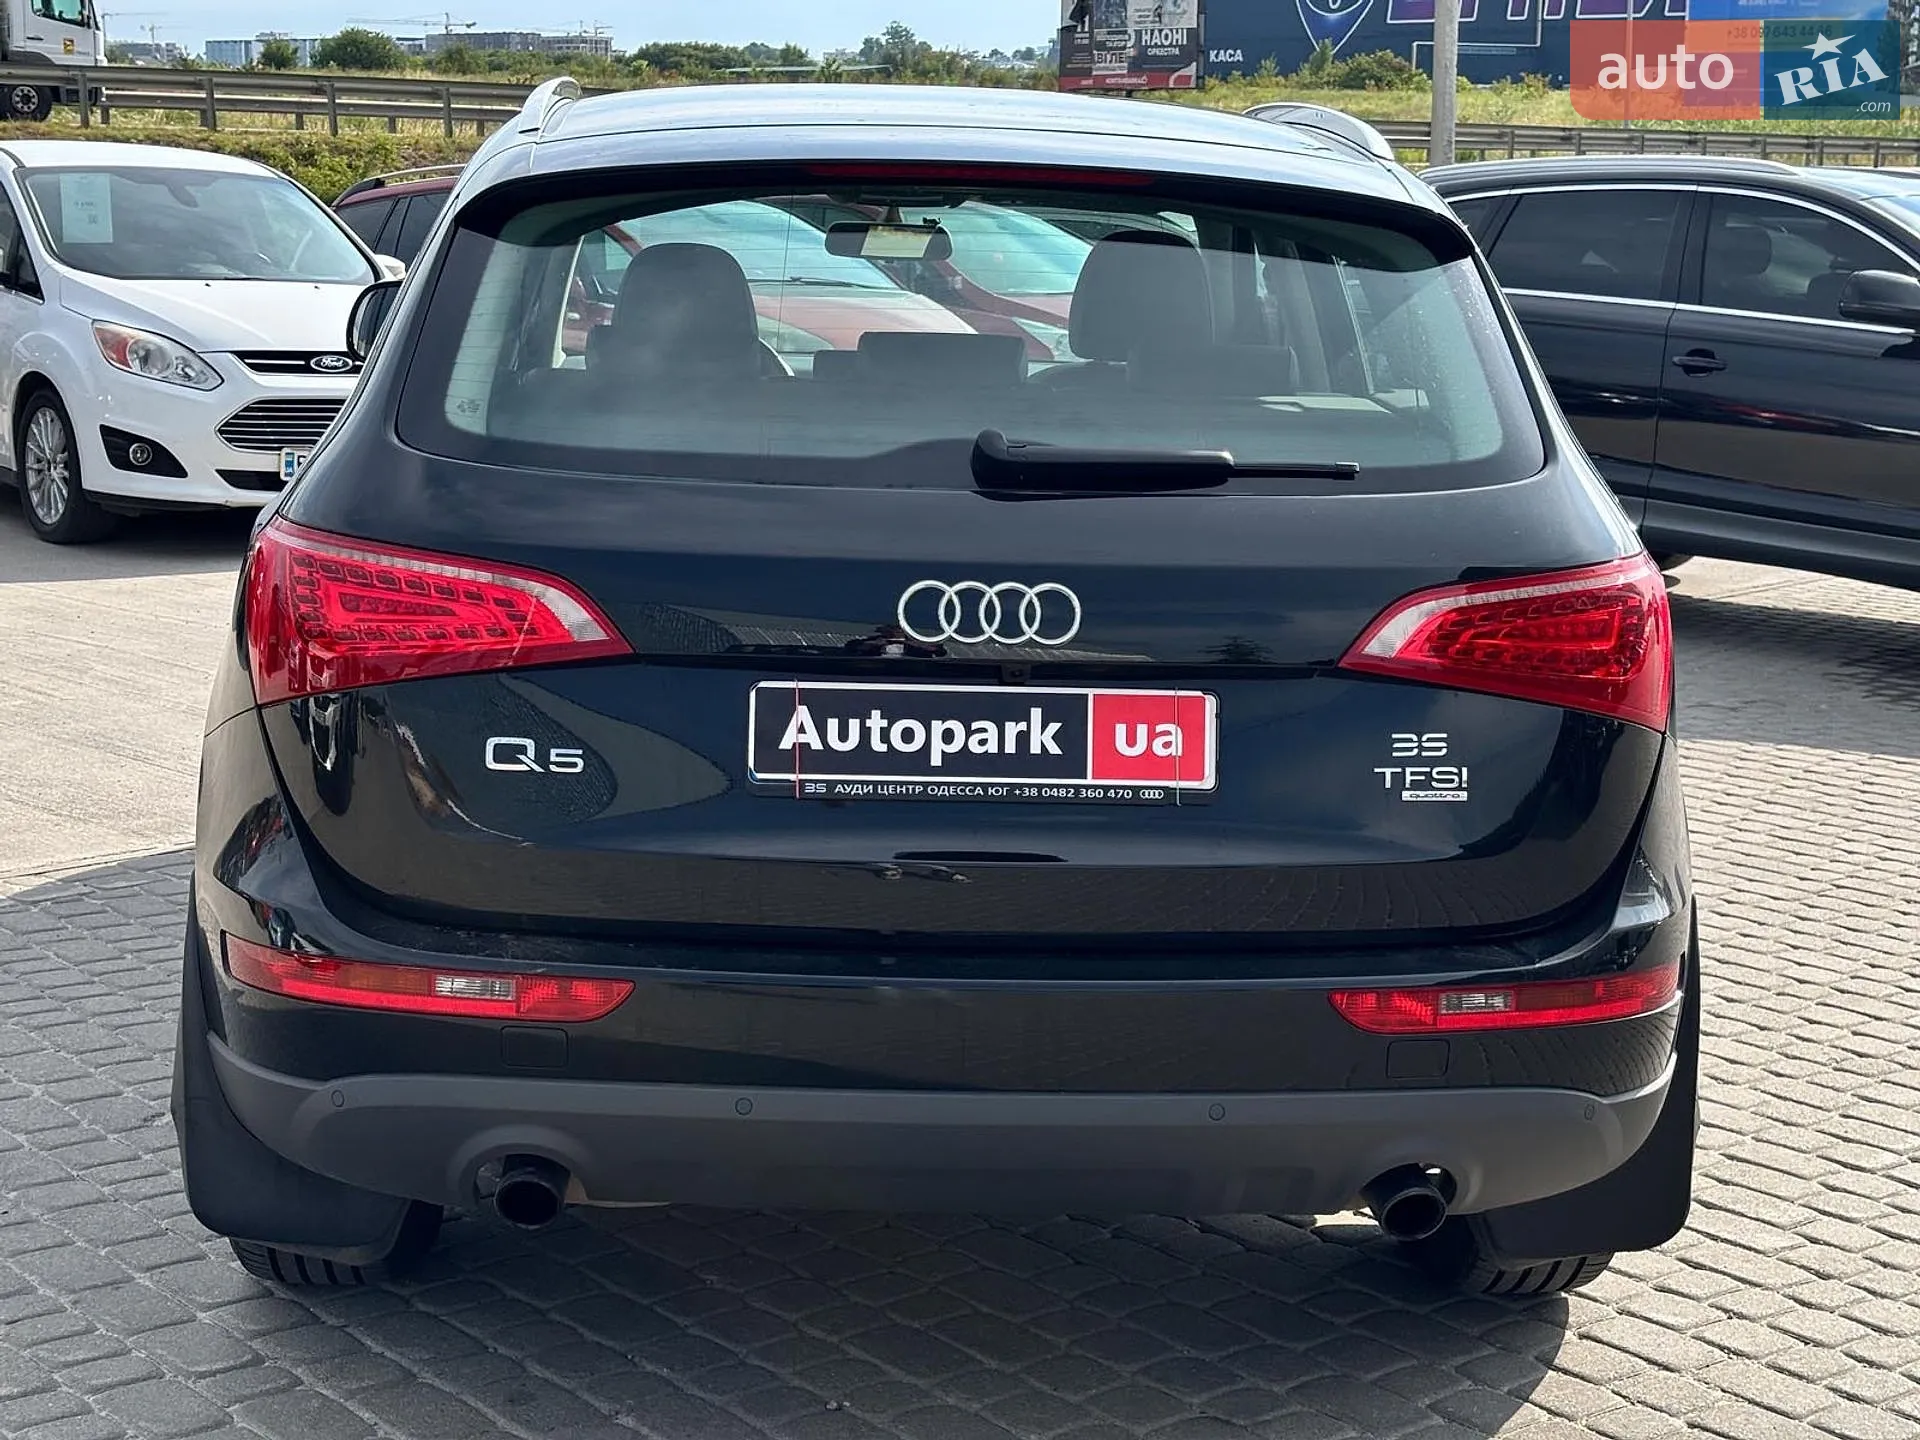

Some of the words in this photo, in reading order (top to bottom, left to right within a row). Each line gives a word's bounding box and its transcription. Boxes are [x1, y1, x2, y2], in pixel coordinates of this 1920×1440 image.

[1141, 28, 1188, 46] НАОНІ
[1209, 49, 1244, 62] КАСА
[320, 357, 345, 368] Ford
[778, 704, 1064, 766] Autopark
[1113, 720, 1184, 757] ua
[485, 736, 585, 773] Q5
[1373, 766, 1468, 789] TFSI
[834, 783, 874, 796] АУДИ
[877, 784, 924, 796] ЦЕНТР
[927, 785, 984, 797] ОДЕССА
[987, 786, 1010, 796] ЮГ
[1013, 787, 1039, 797] +38
[1041, 787, 1076, 798] 0482
[1079, 788, 1104, 798] 360
[1107, 788, 1133, 799] 470
